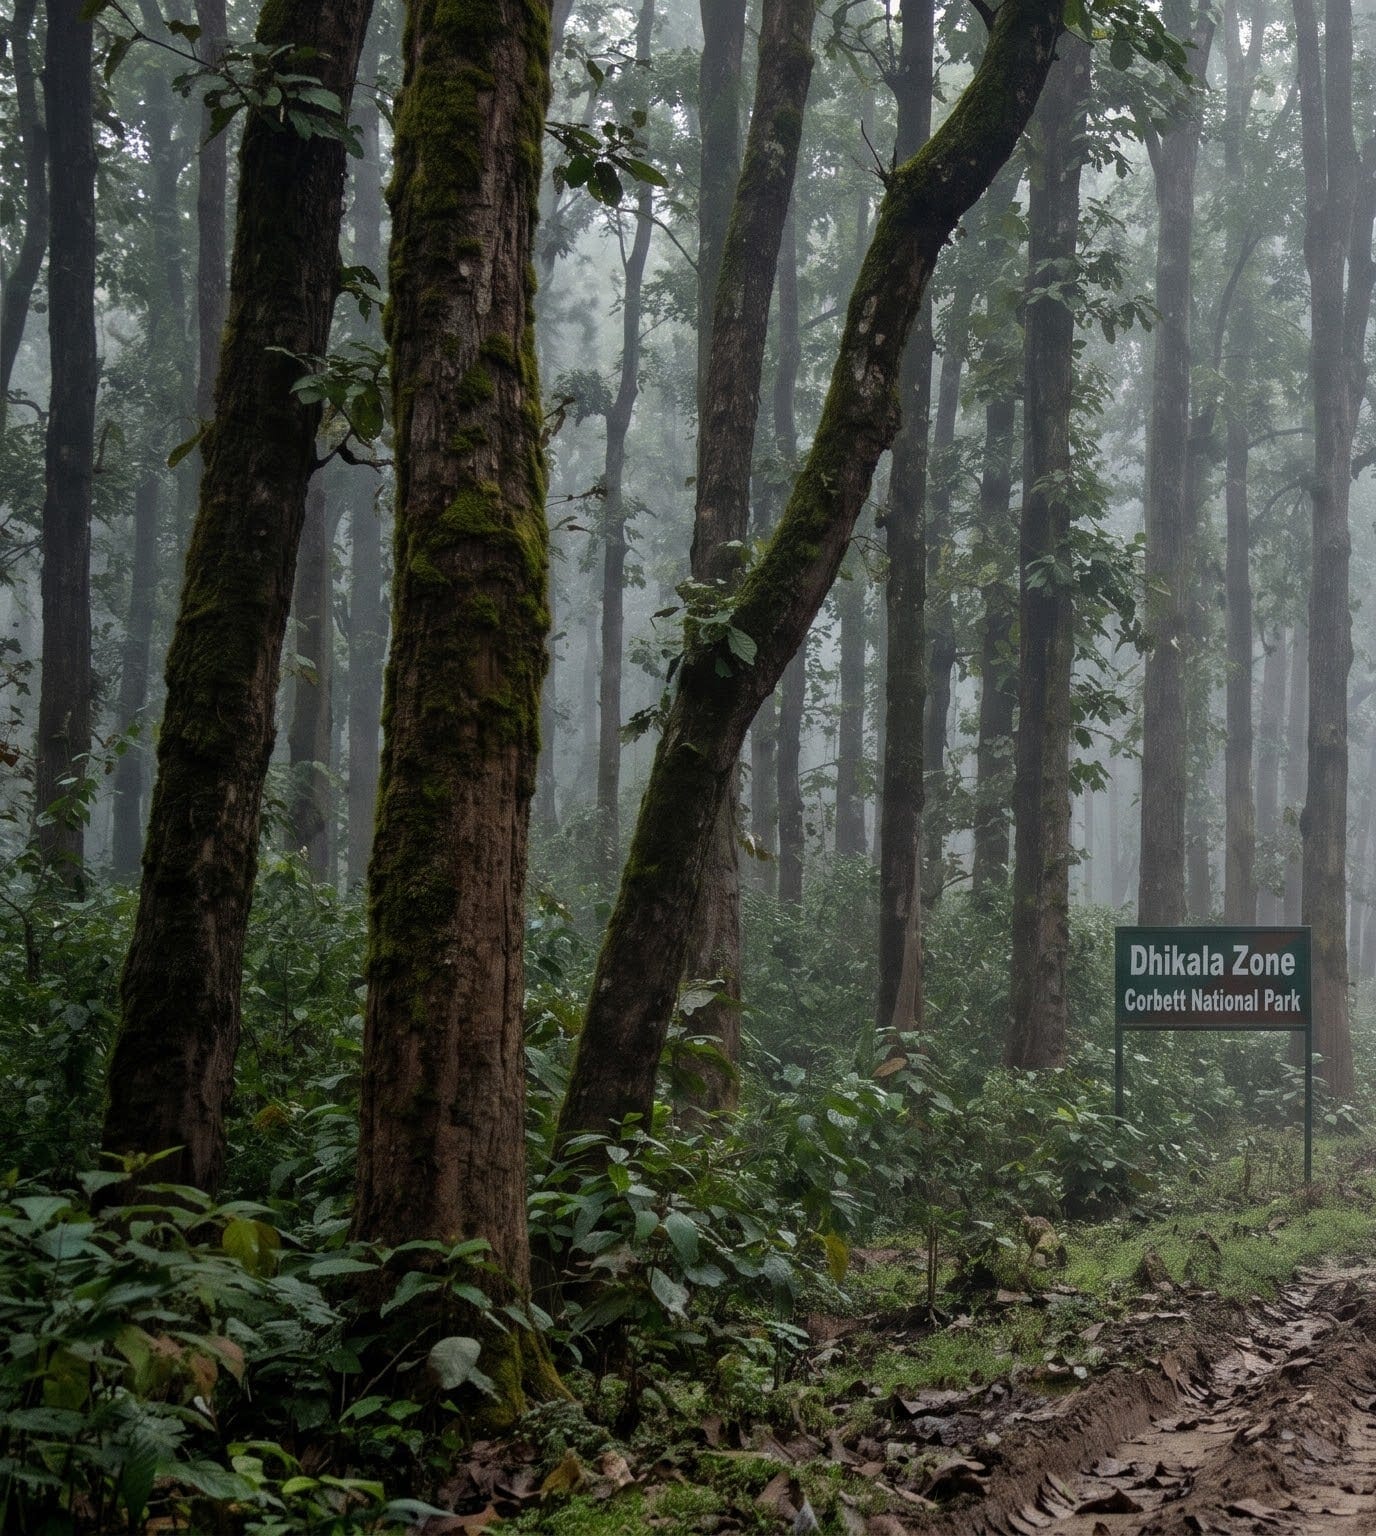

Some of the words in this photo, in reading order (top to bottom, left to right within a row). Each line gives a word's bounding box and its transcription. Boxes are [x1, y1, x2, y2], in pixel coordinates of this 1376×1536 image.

[1130, 944, 1224, 976] Dhikala
[1232, 944, 1296, 976] Zone
[1124, 988, 1187, 1012] Corbett
[1191, 988, 1259, 1012] National
[1264, 988, 1301, 1012] Park
